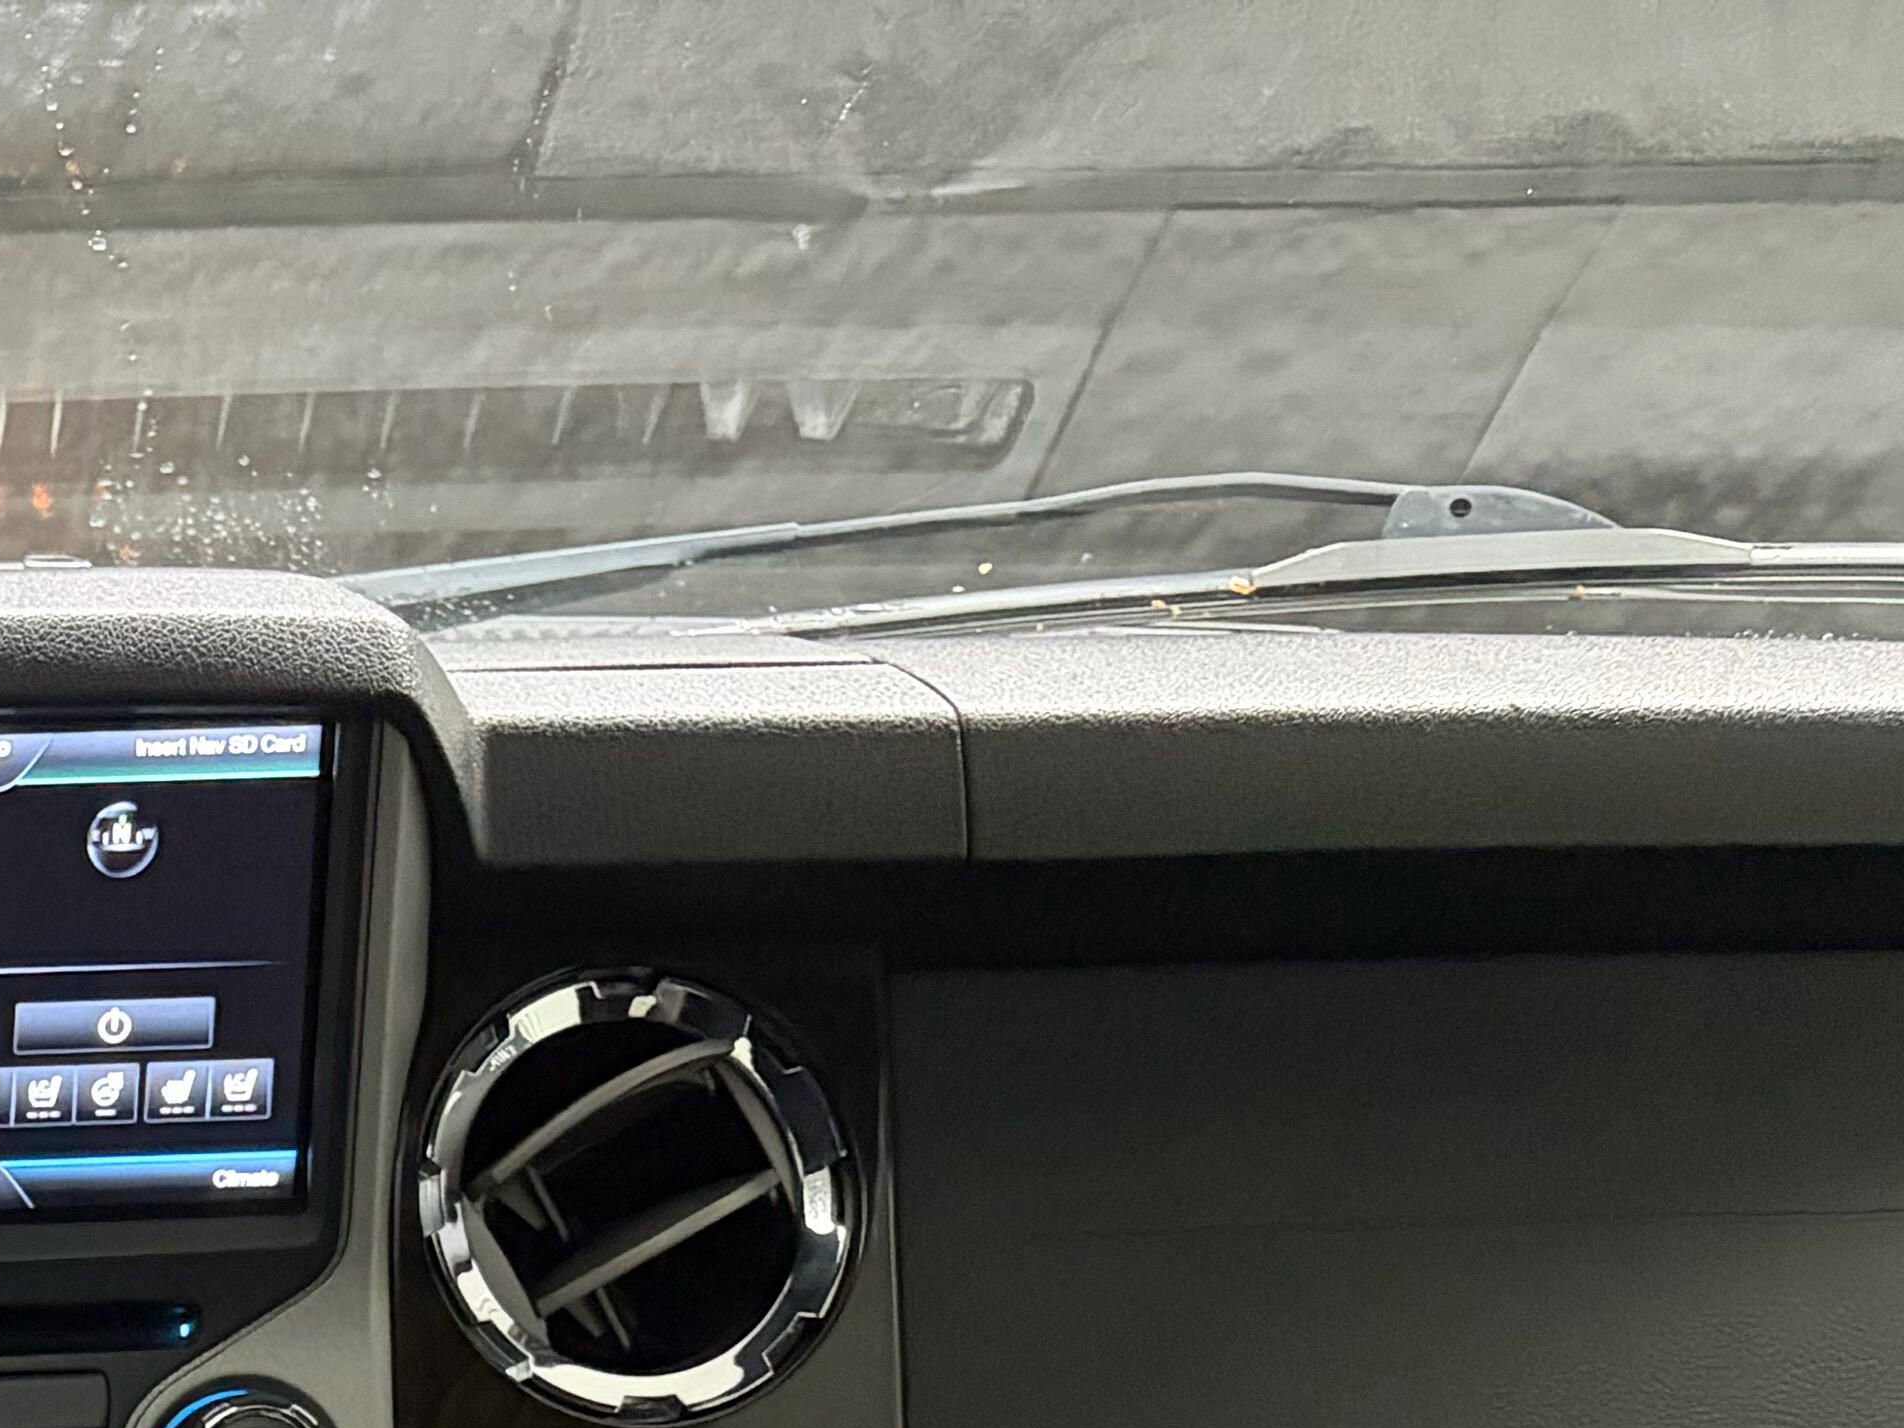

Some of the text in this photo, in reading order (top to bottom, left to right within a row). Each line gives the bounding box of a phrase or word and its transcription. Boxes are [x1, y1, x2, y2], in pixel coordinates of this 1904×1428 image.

[135, 732, 307, 758] Insert Nav SD Card
[213, 1168, 280, 1189] Climate
